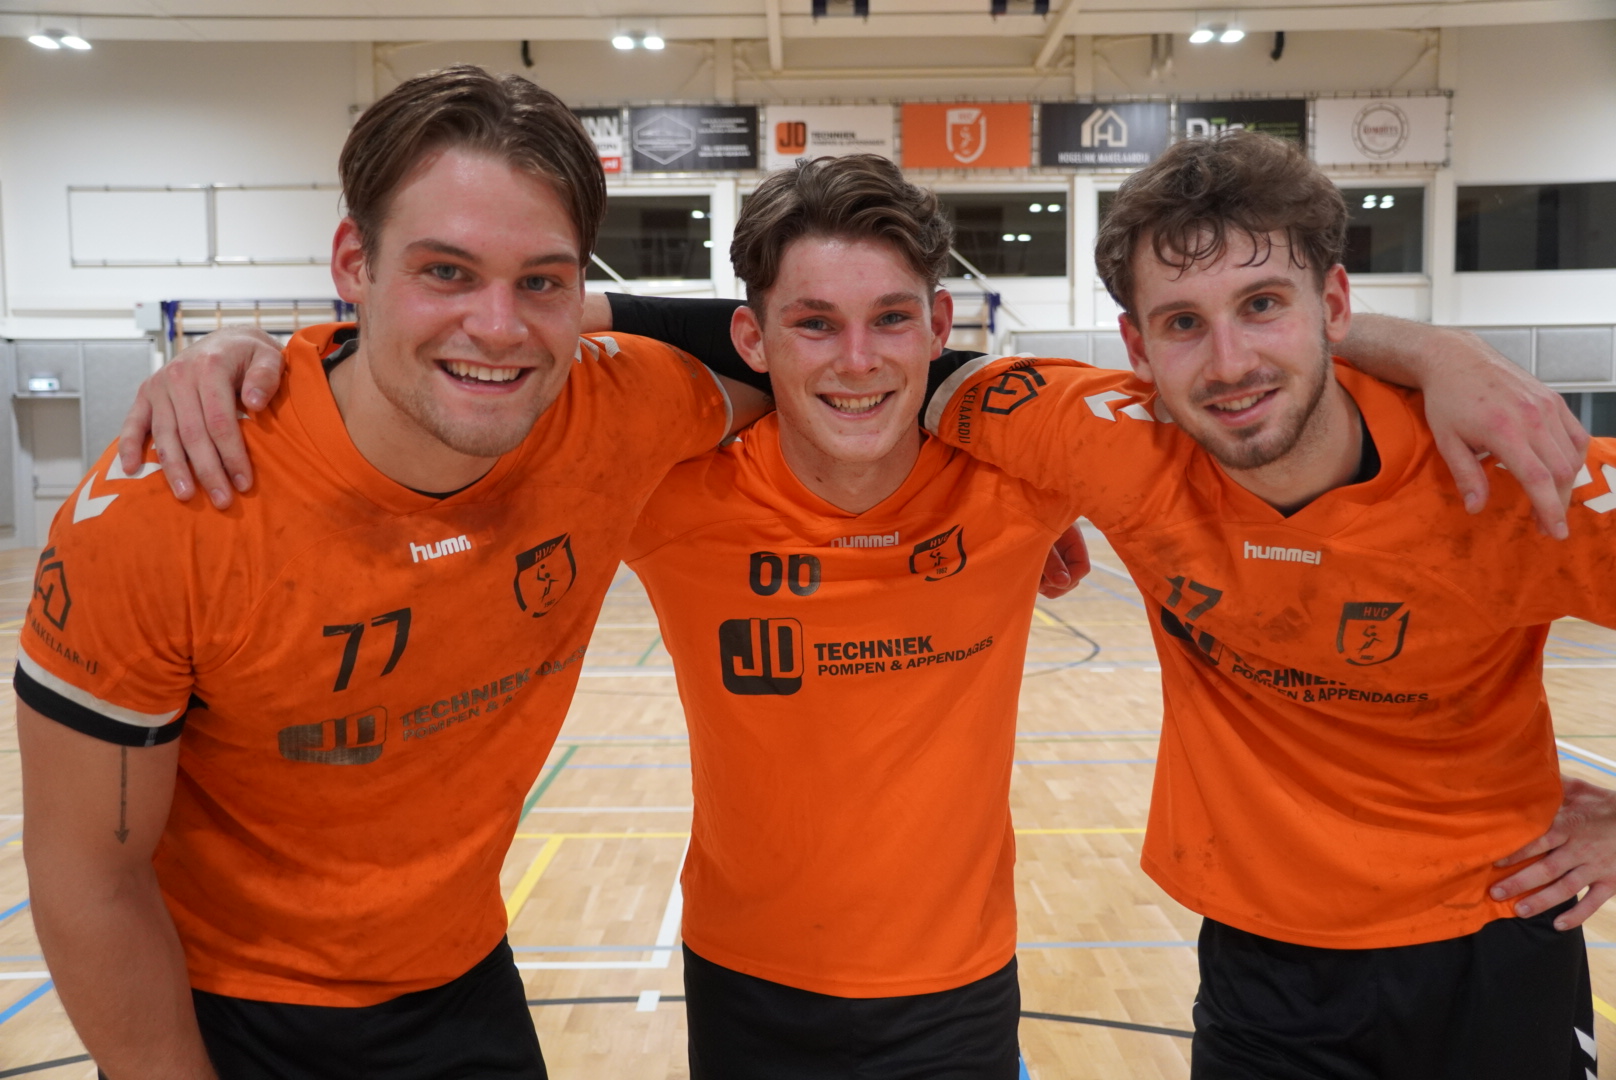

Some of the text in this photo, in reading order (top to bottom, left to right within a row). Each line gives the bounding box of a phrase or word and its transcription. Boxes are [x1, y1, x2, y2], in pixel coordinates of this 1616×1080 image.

[780, 122, 807, 147] JD
[958, 387, 979, 444] KELAARDIJ
[1244, 541, 1321, 565] hummel
[1166, 576, 1223, 621] 17
[1363, 606, 1389, 618] HVC
[323, 607, 411, 693] 77
[732, 617, 804, 678] JD
[814, 635, 934, 662] TECHNIEK
[818, 636, 994, 676] POMPEN & APPENDAGES
[400, 668, 530, 727] TECHNIEK
[1303, 690, 1315, 702] &
[1318, 687, 1429, 704] APPENDAGES
[403, 706, 480, 742] POMPEN
